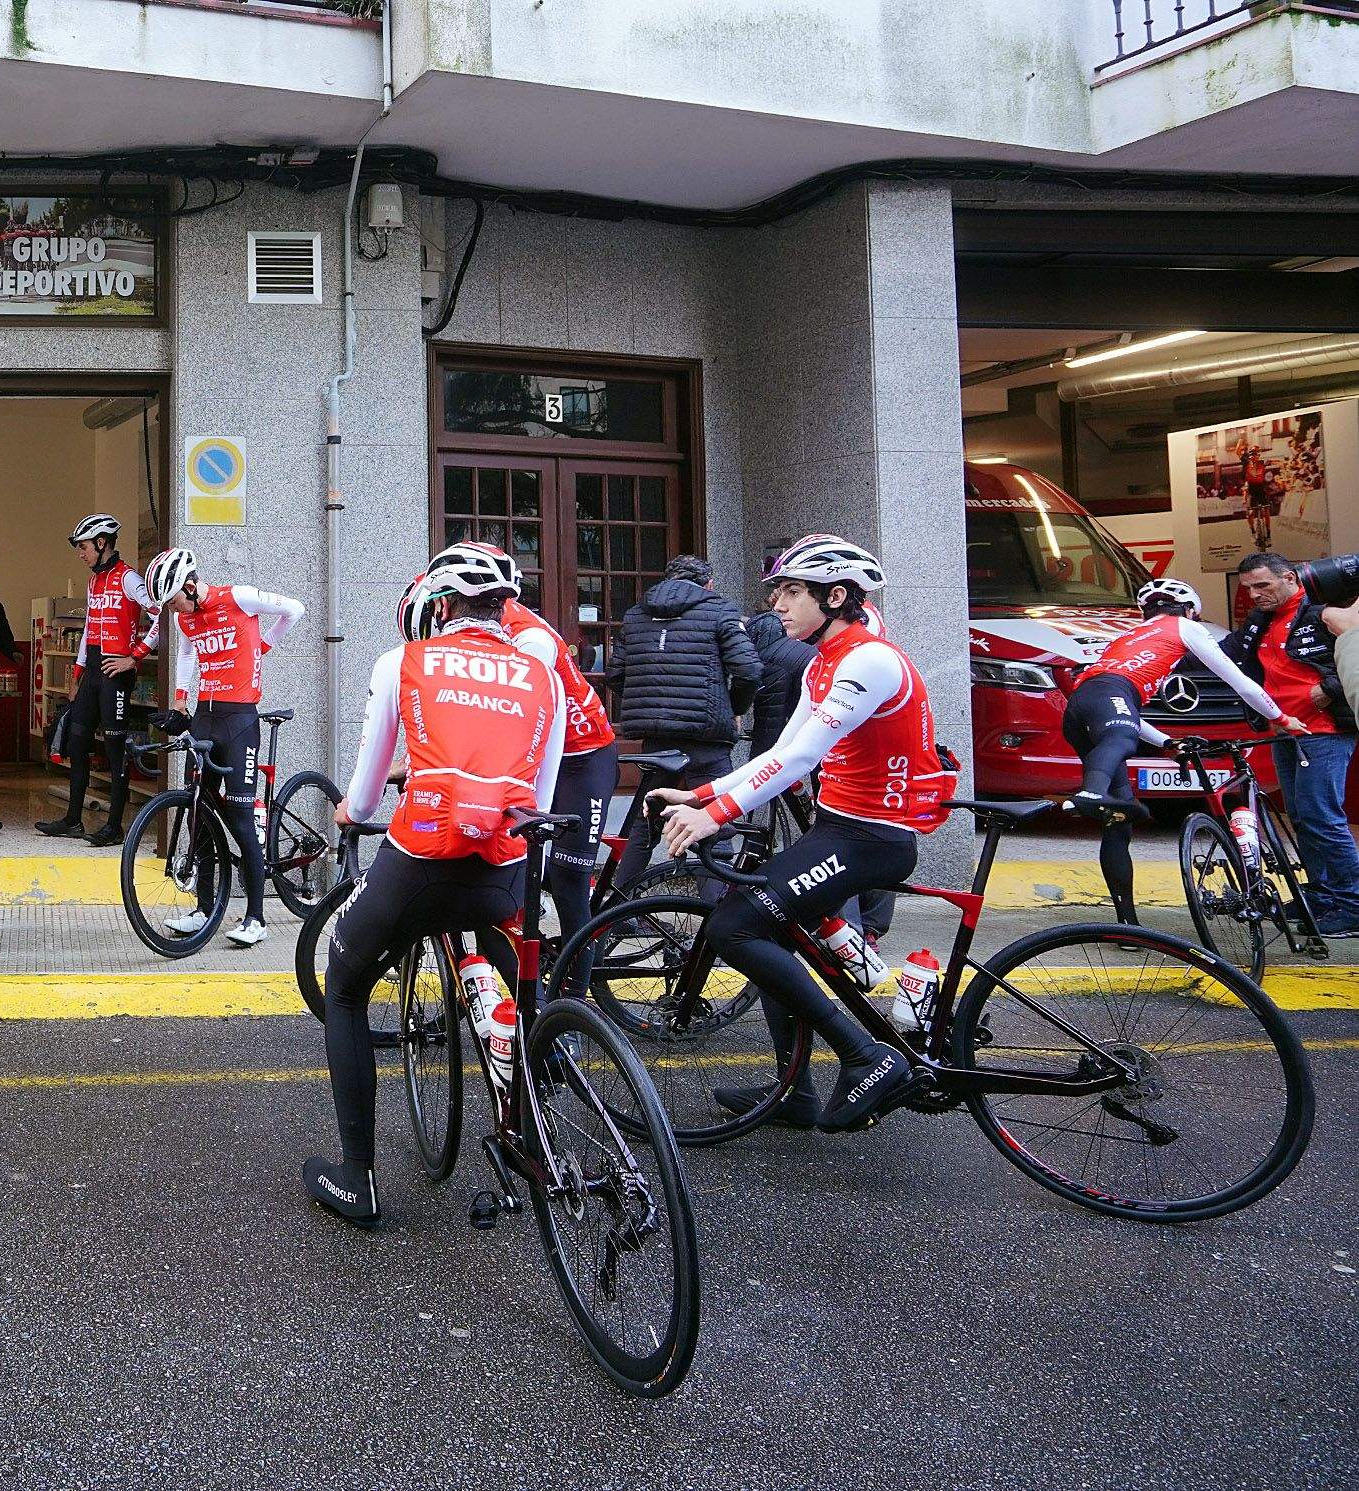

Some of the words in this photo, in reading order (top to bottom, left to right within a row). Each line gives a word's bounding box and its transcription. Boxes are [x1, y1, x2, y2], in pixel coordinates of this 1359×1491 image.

[12, 237, 106, 262] GRUPO
[548, 397, 560, 420] 3
[424, 652, 533, 692] FROIZ
[116, 690, 125, 720] FROIZ
[411, 689, 429, 744] OTTOBOSLEY
[244, 746, 256, 784] FROIZ
[749, 757, 784, 791] FROIZ
[1151, 772, 1190, 786] 008
[589, 798, 603, 843] FROIZ
[788, 854, 847, 896] FROIZ
[847, 1055, 895, 1103] OTTOBOSLEY
[317, 1174, 357, 1203] OTTOBOSLEY
